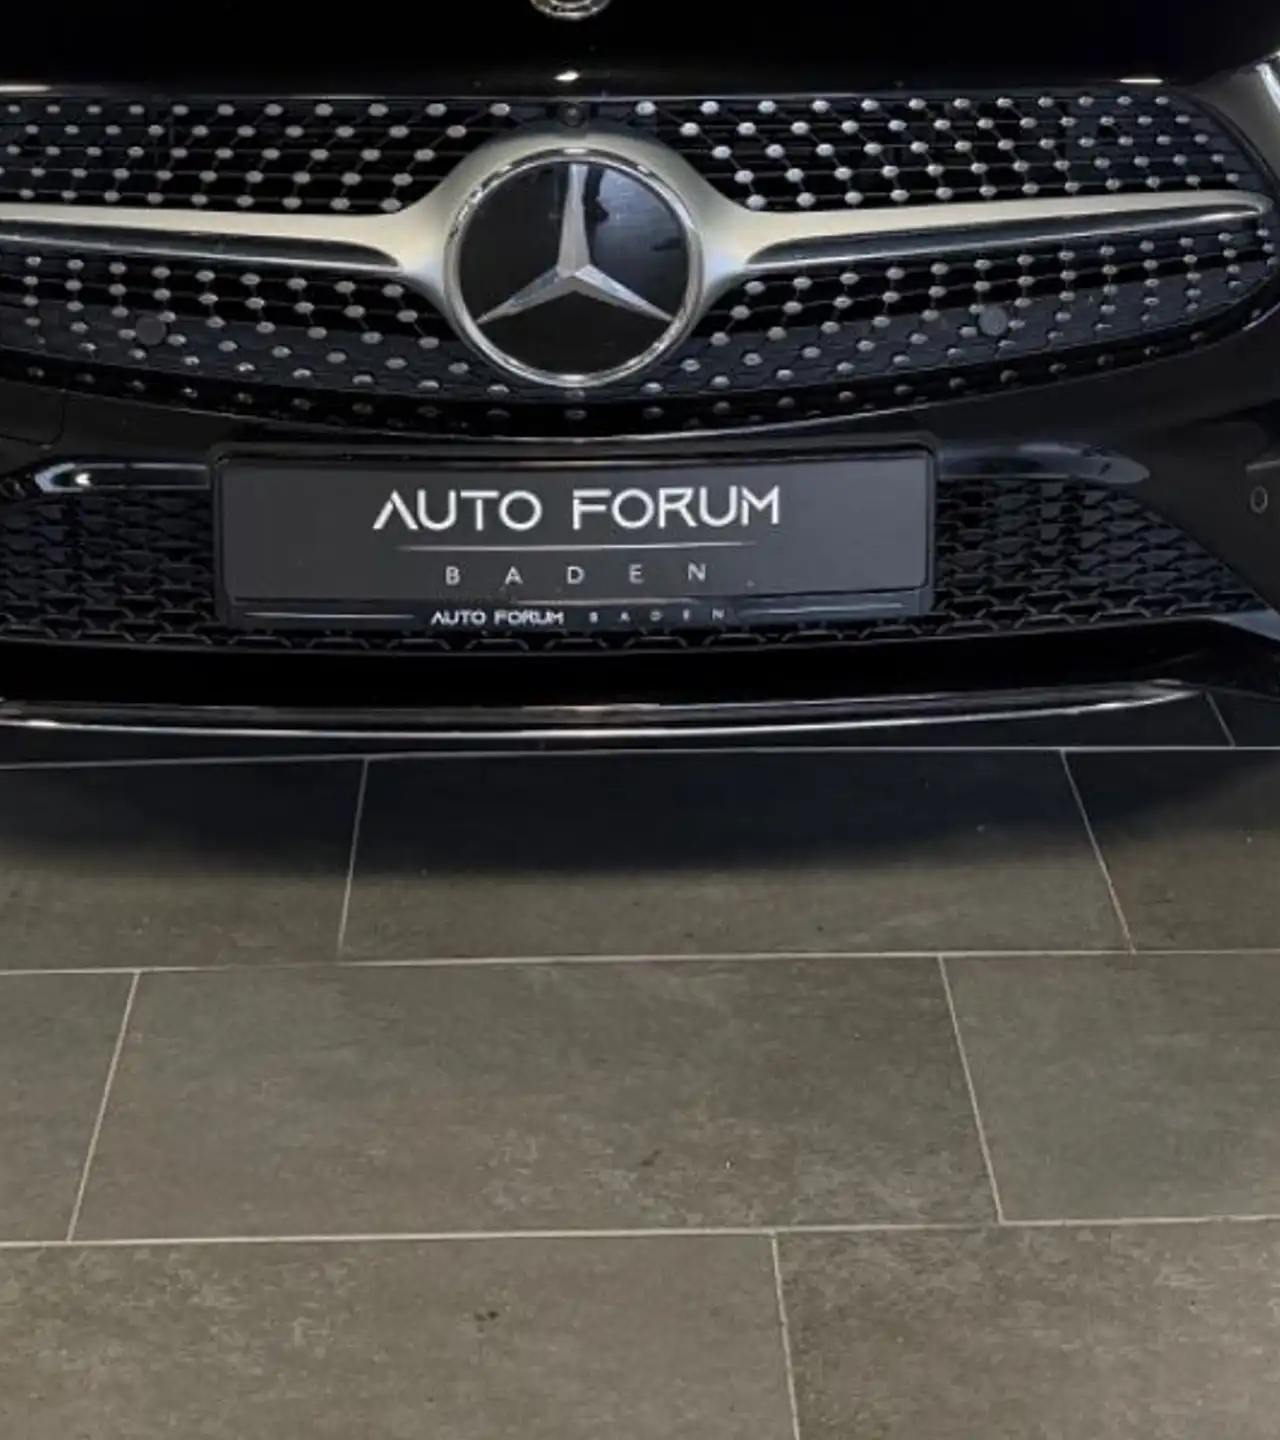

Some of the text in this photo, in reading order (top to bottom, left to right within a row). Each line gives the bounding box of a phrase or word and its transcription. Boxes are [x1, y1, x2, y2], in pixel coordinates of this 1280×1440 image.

[372, 485, 782, 532] AUTO FORUM
[430, 608, 488, 626] AUTO
[493, 609, 566, 627] FORUM
